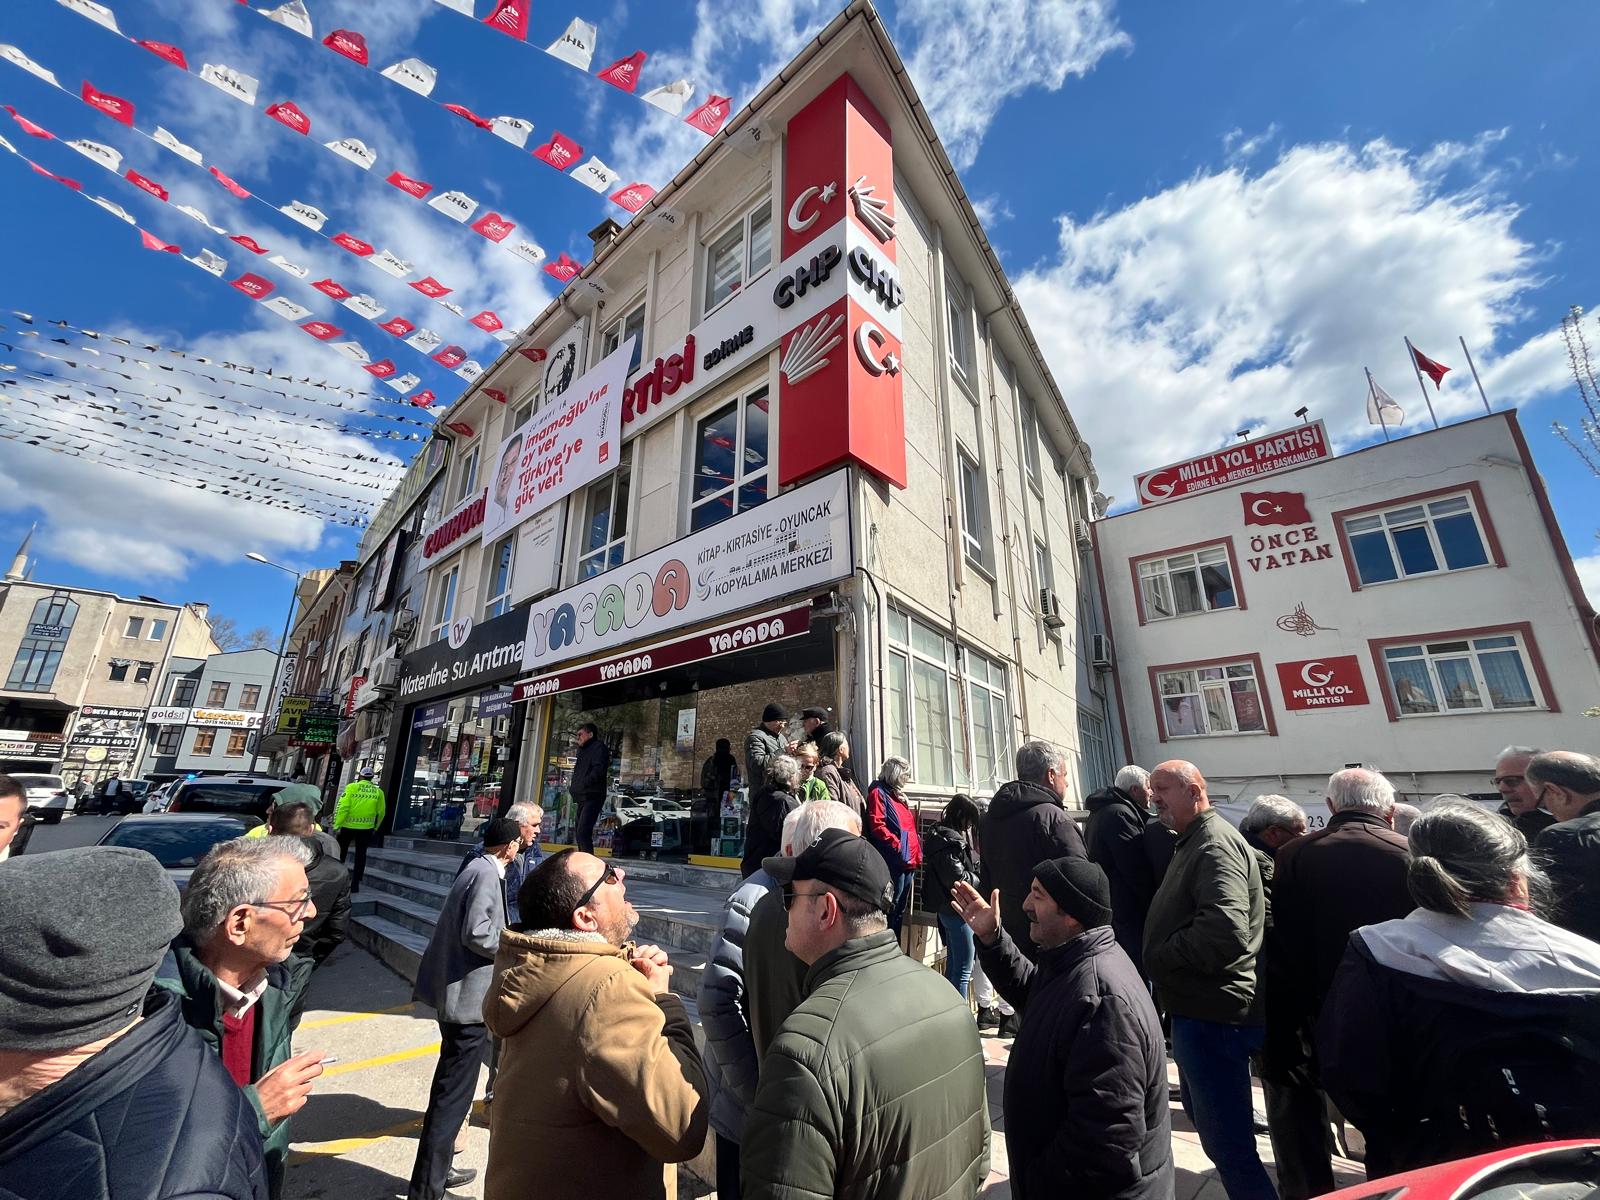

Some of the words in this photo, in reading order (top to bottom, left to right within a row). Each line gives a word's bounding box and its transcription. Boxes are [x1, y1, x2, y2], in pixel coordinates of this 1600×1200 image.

[773, 244, 842, 309] CHP
[704, 325, 754, 371] EDİRNE
[518, 438, 583, 490] Türkiye'ye
[521, 449, 536, 469] oy
[538, 433, 559, 456] ver
[1179, 456, 1218, 482] MİLLİ
[1220, 449, 1252, 469] YOL
[1256, 425, 1320, 459] PARTİSİ
[1186, 476, 1210, 493] EDİRNE
[1211, 475, 1218, 486] İL
[1219, 475, 1227, 483] ve
[1227, 466, 1256, 481] MERKEZ
[1256, 460, 1273, 475] İLÇE
[1274, 448, 1318, 470] BAŞKANLIĞI
[514, 486, 535, 514] güç
[538, 464, 563, 494] ver!
[697, 545, 720, 566] KİTAP
[726, 524, 773, 554] KIRTASİYE
[780, 500, 832, 533] OYUNCAK
[1250, 526, 1319, 553] ÖNCE
[715, 565, 778, 597] KOPYALAMA
[780, 546, 833, 575] MERKEZİ
[1247, 544, 1333, 572] VATAN
[533, 558, 691, 657] YAPADA
[708, 618, 785, 654] YAPADA
[400, 661, 449, 697] Waterline
[451, 661, 468, 681] Su
[469, 640, 525, 676] Arıtma
[523, 678, 560, 698] YAPADA
[600, 654, 652, 681] YAPADA
[1292, 686, 1325, 699] MİLLİ
[1328, 685, 1353, 695] YOL
[1306, 695, 1344, 706] PARTİSİ
[1307, 816, 1325, 828] 23
